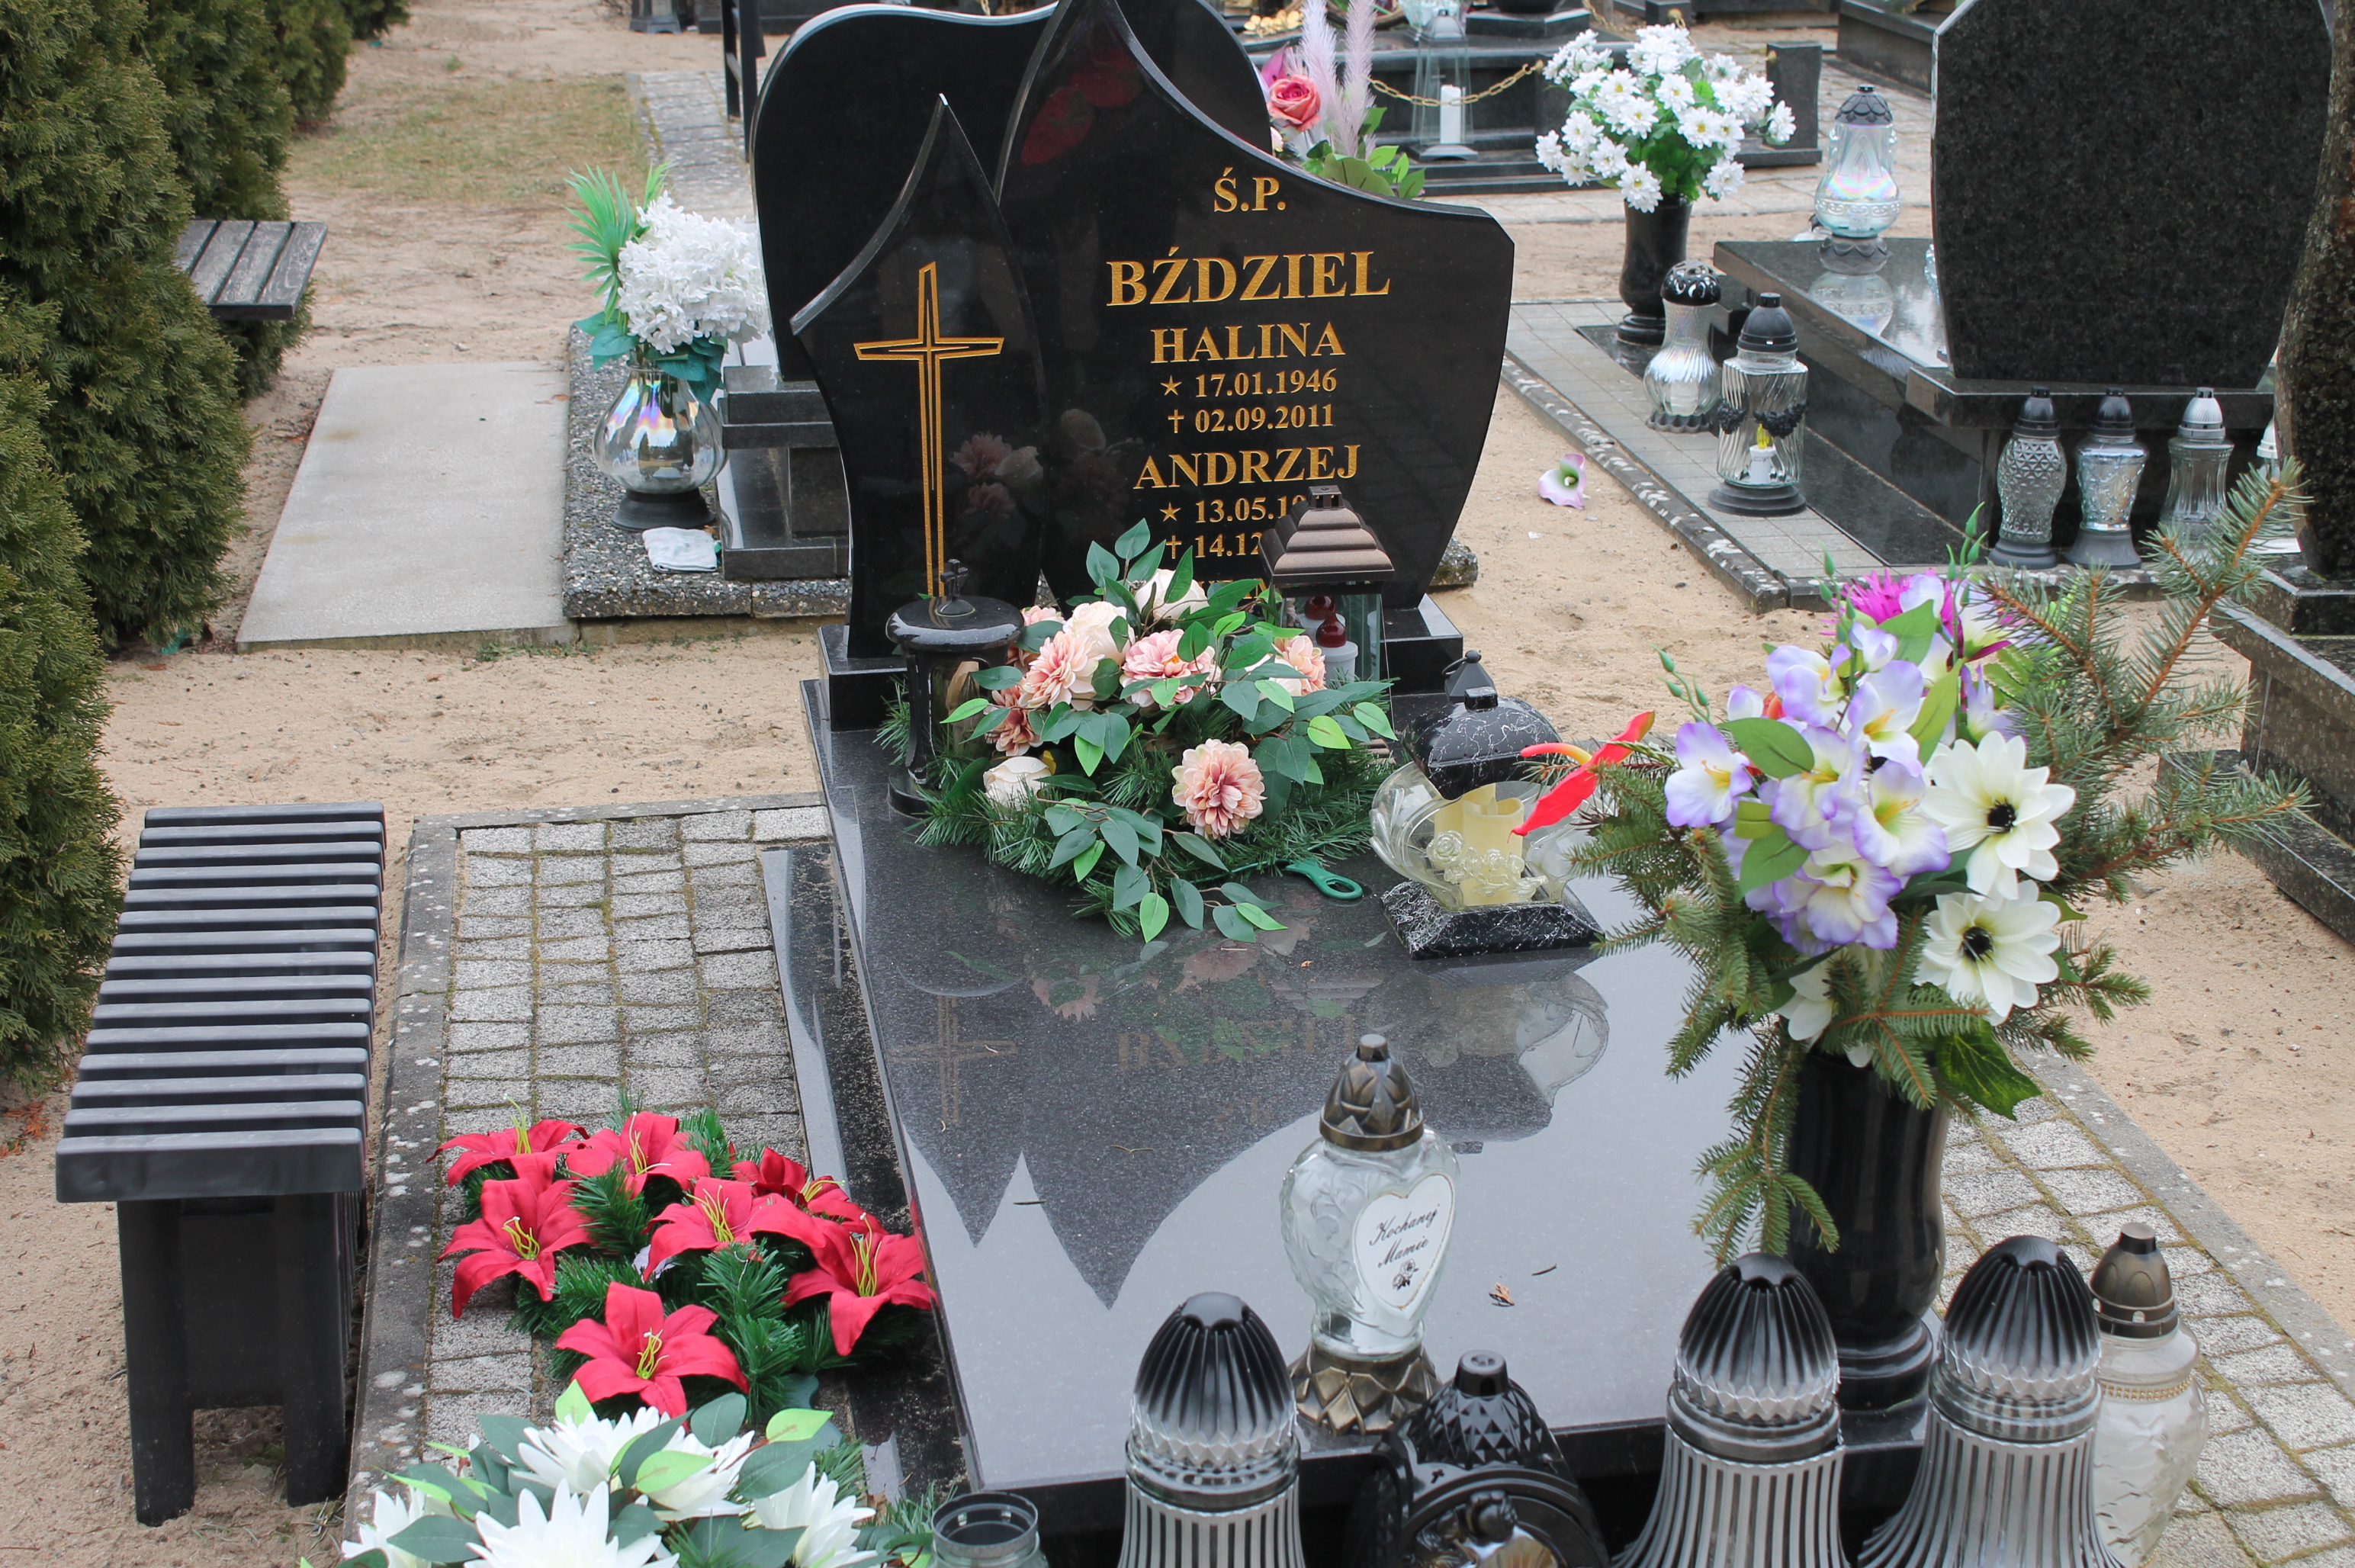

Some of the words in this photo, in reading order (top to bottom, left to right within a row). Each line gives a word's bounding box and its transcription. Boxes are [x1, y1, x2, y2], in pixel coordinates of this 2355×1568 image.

[1213, 167, 1287, 212] Ś.P.
[1106, 246, 1391, 307] BŹDZIEL
[1150, 321, 1346, 364] HALINA
[1194, 368, 1338, 397] 17.01.1946
[1194, 403, 1334, 433] 02.09.2011
[1133, 444, 1361, 490] ANDRZEJ
[1195, 494, 1335, 523] 13.05.1
[1369, 1203, 1440, 1246] Kochanej
[1377, 1235, 1429, 1268] Mamie
